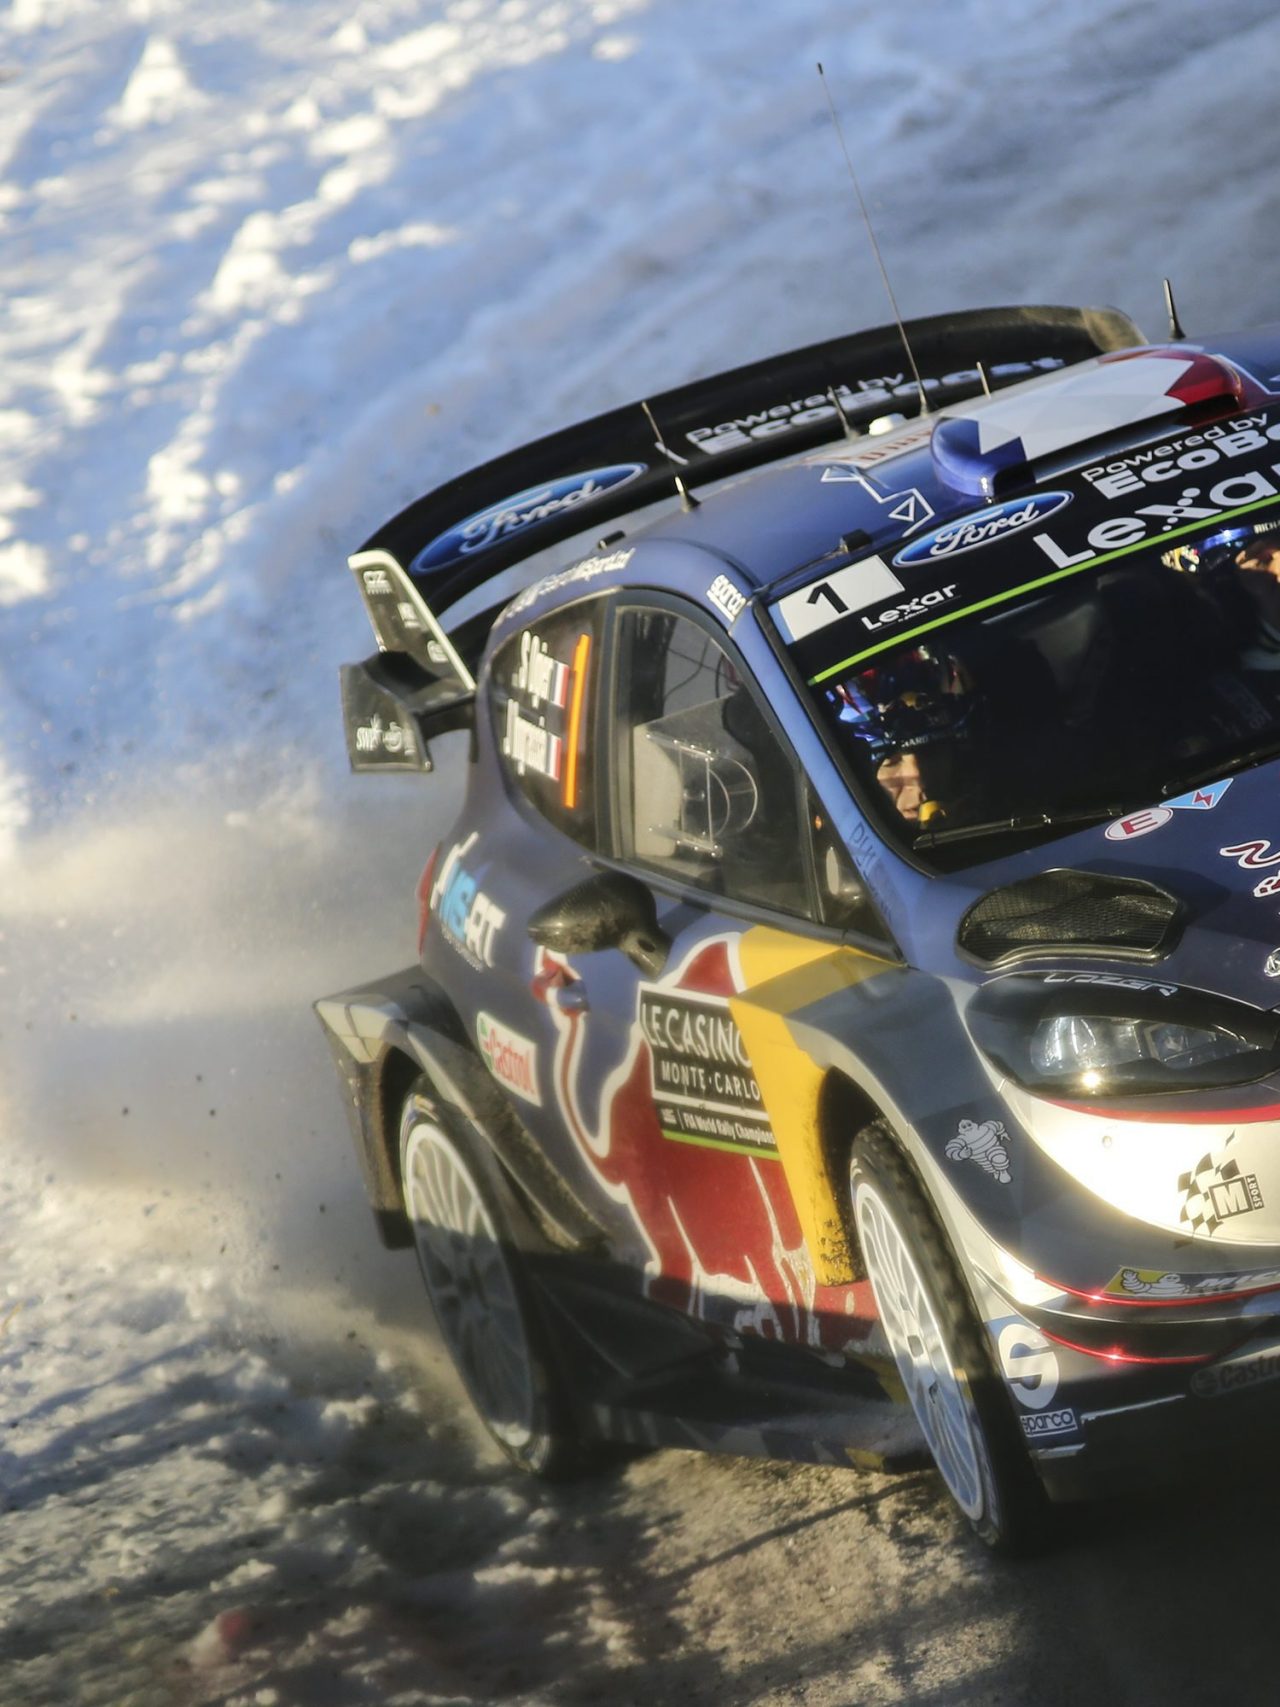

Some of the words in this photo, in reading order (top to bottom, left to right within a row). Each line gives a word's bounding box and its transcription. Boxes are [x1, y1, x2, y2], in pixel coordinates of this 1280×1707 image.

[1081, 424, 1227, 483] Powered
[1237, 411, 1268, 432] by
[929, 501, 1040, 556] Ford
[807, 582, 849, 614] 1
[861, 583, 957, 631] Lexar
[1120, 811, 1158, 836] E
[1043, 972, 1179, 997] LAZER
